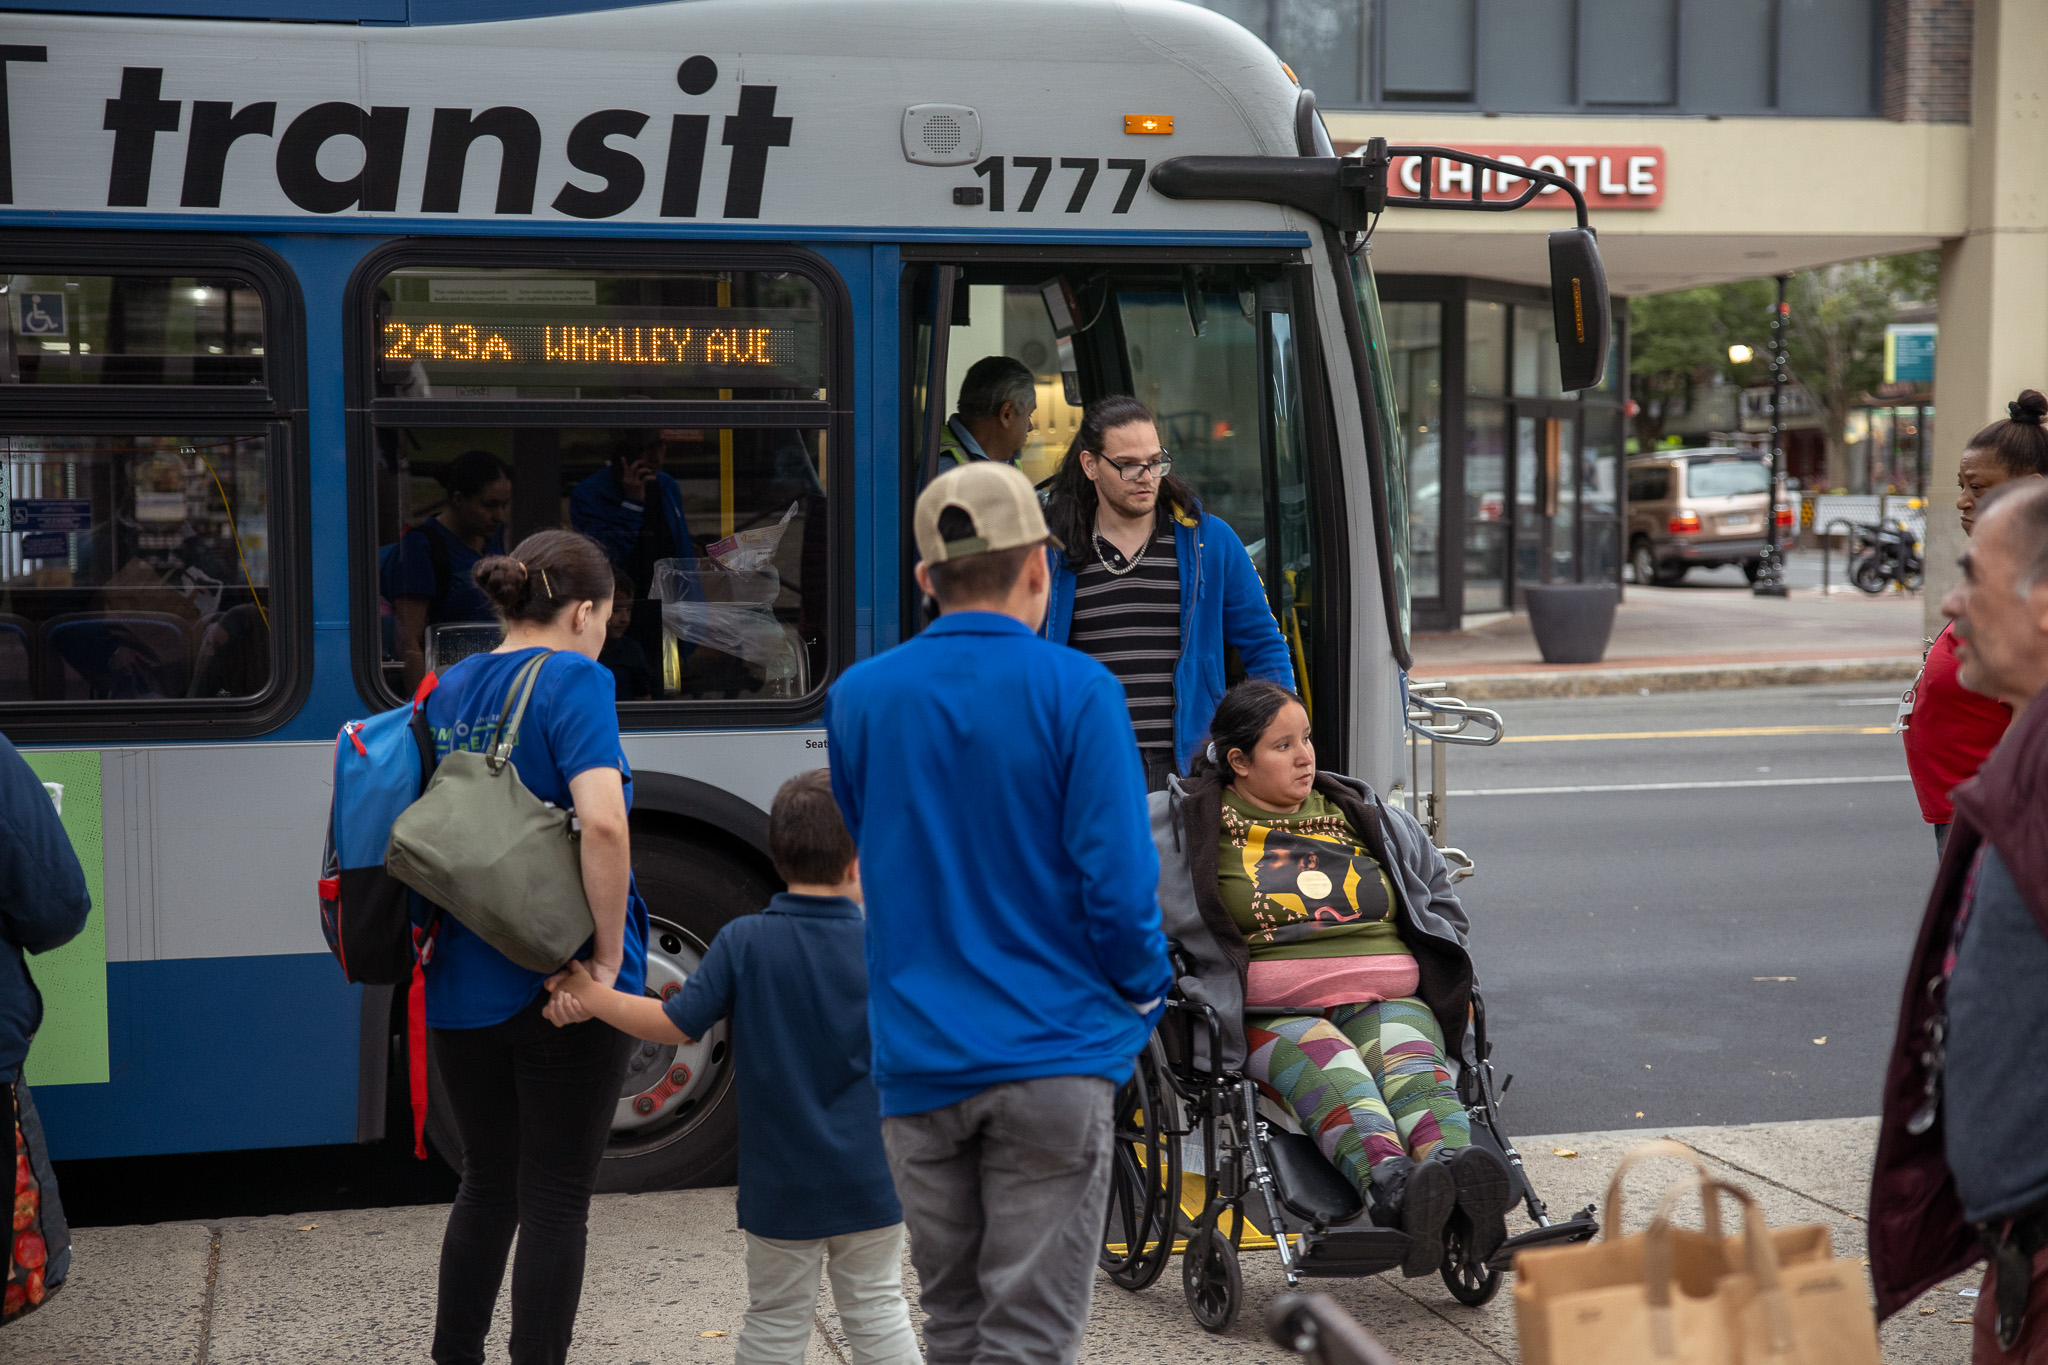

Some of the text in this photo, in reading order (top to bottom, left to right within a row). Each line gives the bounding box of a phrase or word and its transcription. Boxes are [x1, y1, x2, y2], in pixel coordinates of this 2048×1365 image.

[103, 55, 794, 220] transit
[973, 155, 1147, 214] 1777
[1400, 154, 1658, 195] CHIPOTLE
[545, 325, 691, 362] WHALLEY
[707, 328, 771, 363] AVE
